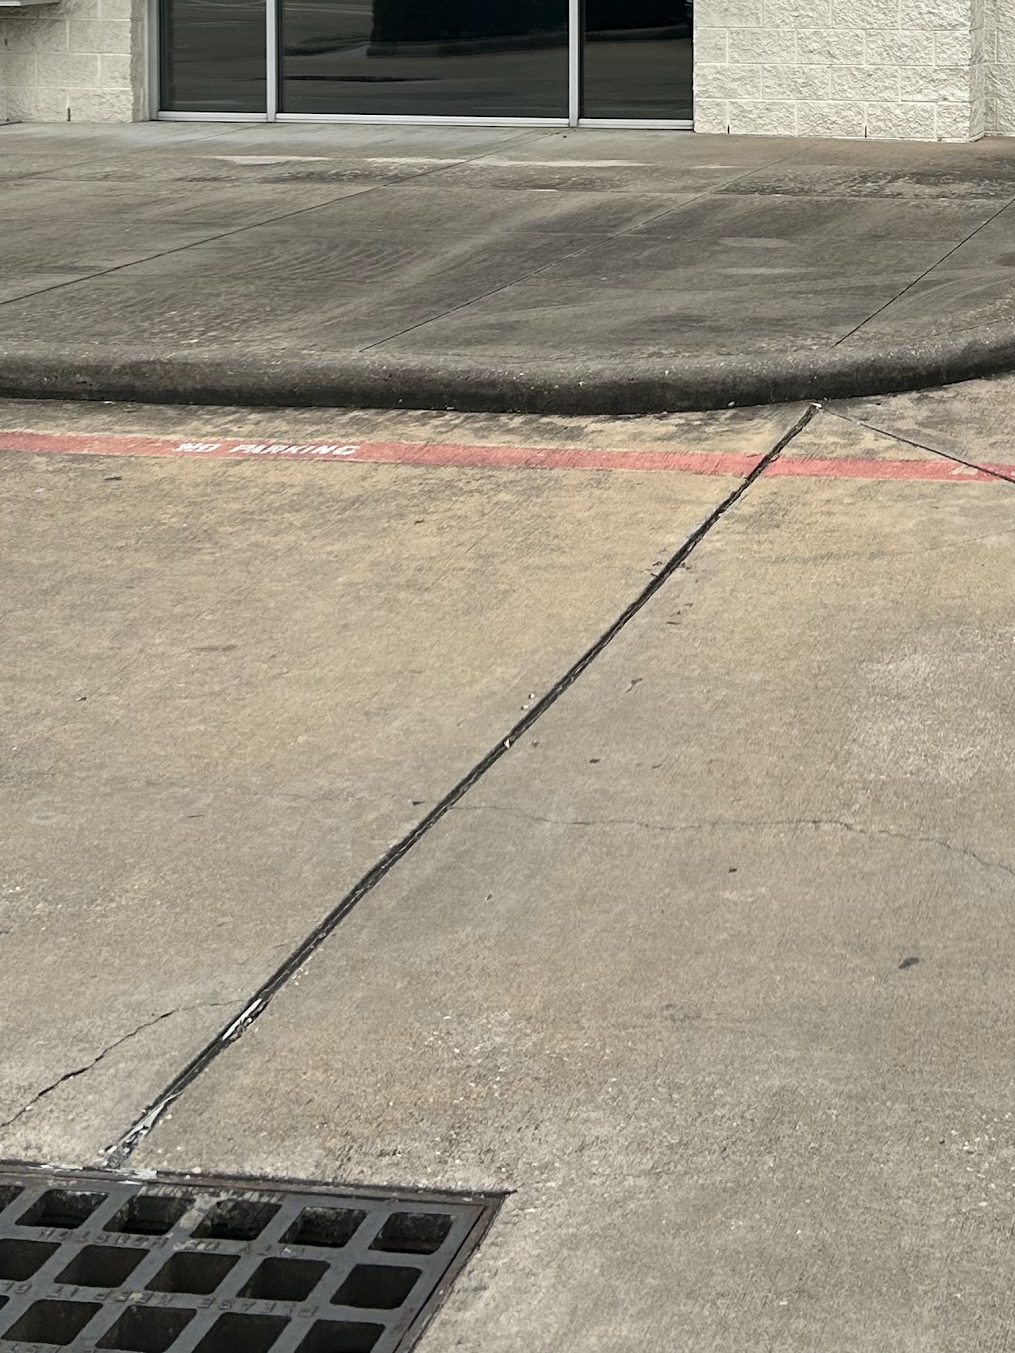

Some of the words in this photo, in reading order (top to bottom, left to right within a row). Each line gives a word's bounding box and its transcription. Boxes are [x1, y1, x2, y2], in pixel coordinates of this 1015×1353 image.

[172, 442, 221, 453] NO
[228, 444, 361, 456] PARKING
[197, 1297, 320, 1318] PLEASE
